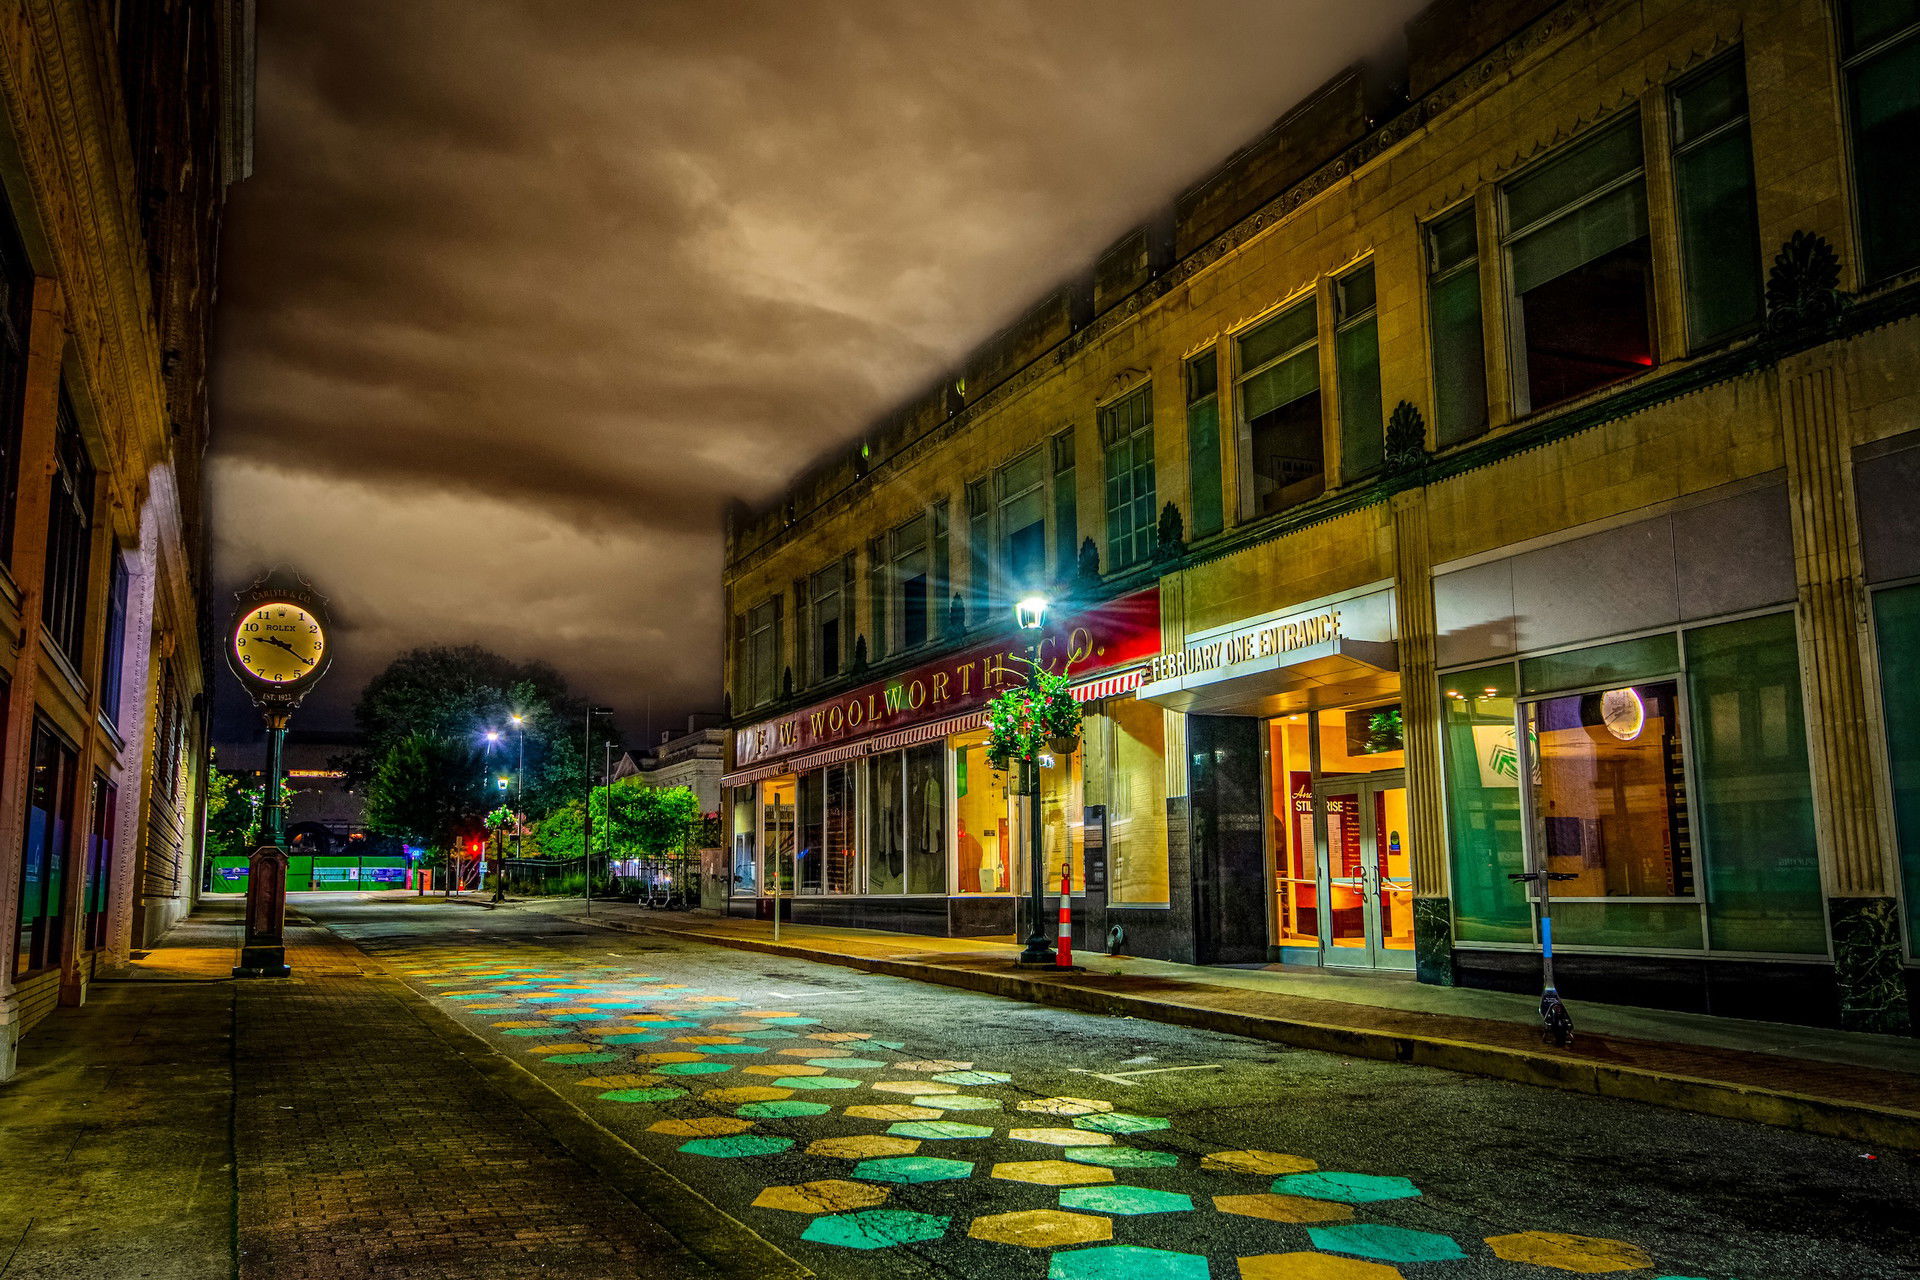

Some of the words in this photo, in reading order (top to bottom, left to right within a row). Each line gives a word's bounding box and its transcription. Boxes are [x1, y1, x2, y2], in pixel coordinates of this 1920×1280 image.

[257, 611, 270, 620] 11
[299, 613, 305, 621] 1
[244, 623, 259, 631] 10
[309, 625, 318, 633] 2
[238, 638, 246, 646] 9
[314, 642, 322, 650] 3
[1152, 642, 1222, 682] FEBRUARY
[1226, 633, 1255, 666] ONE
[1259, 611, 1342, 657] ENTRANCE
[242, 655, 251, 664] 8
[257, 669, 265, 677] 7
[274, 673, 283, 681] 6
[294, 669, 302, 678] 5
[780, 721, 798, 747] W.
[810, 652, 1004, 737] WOOLWORTH
[1037, 627, 1105, 672] CO.
